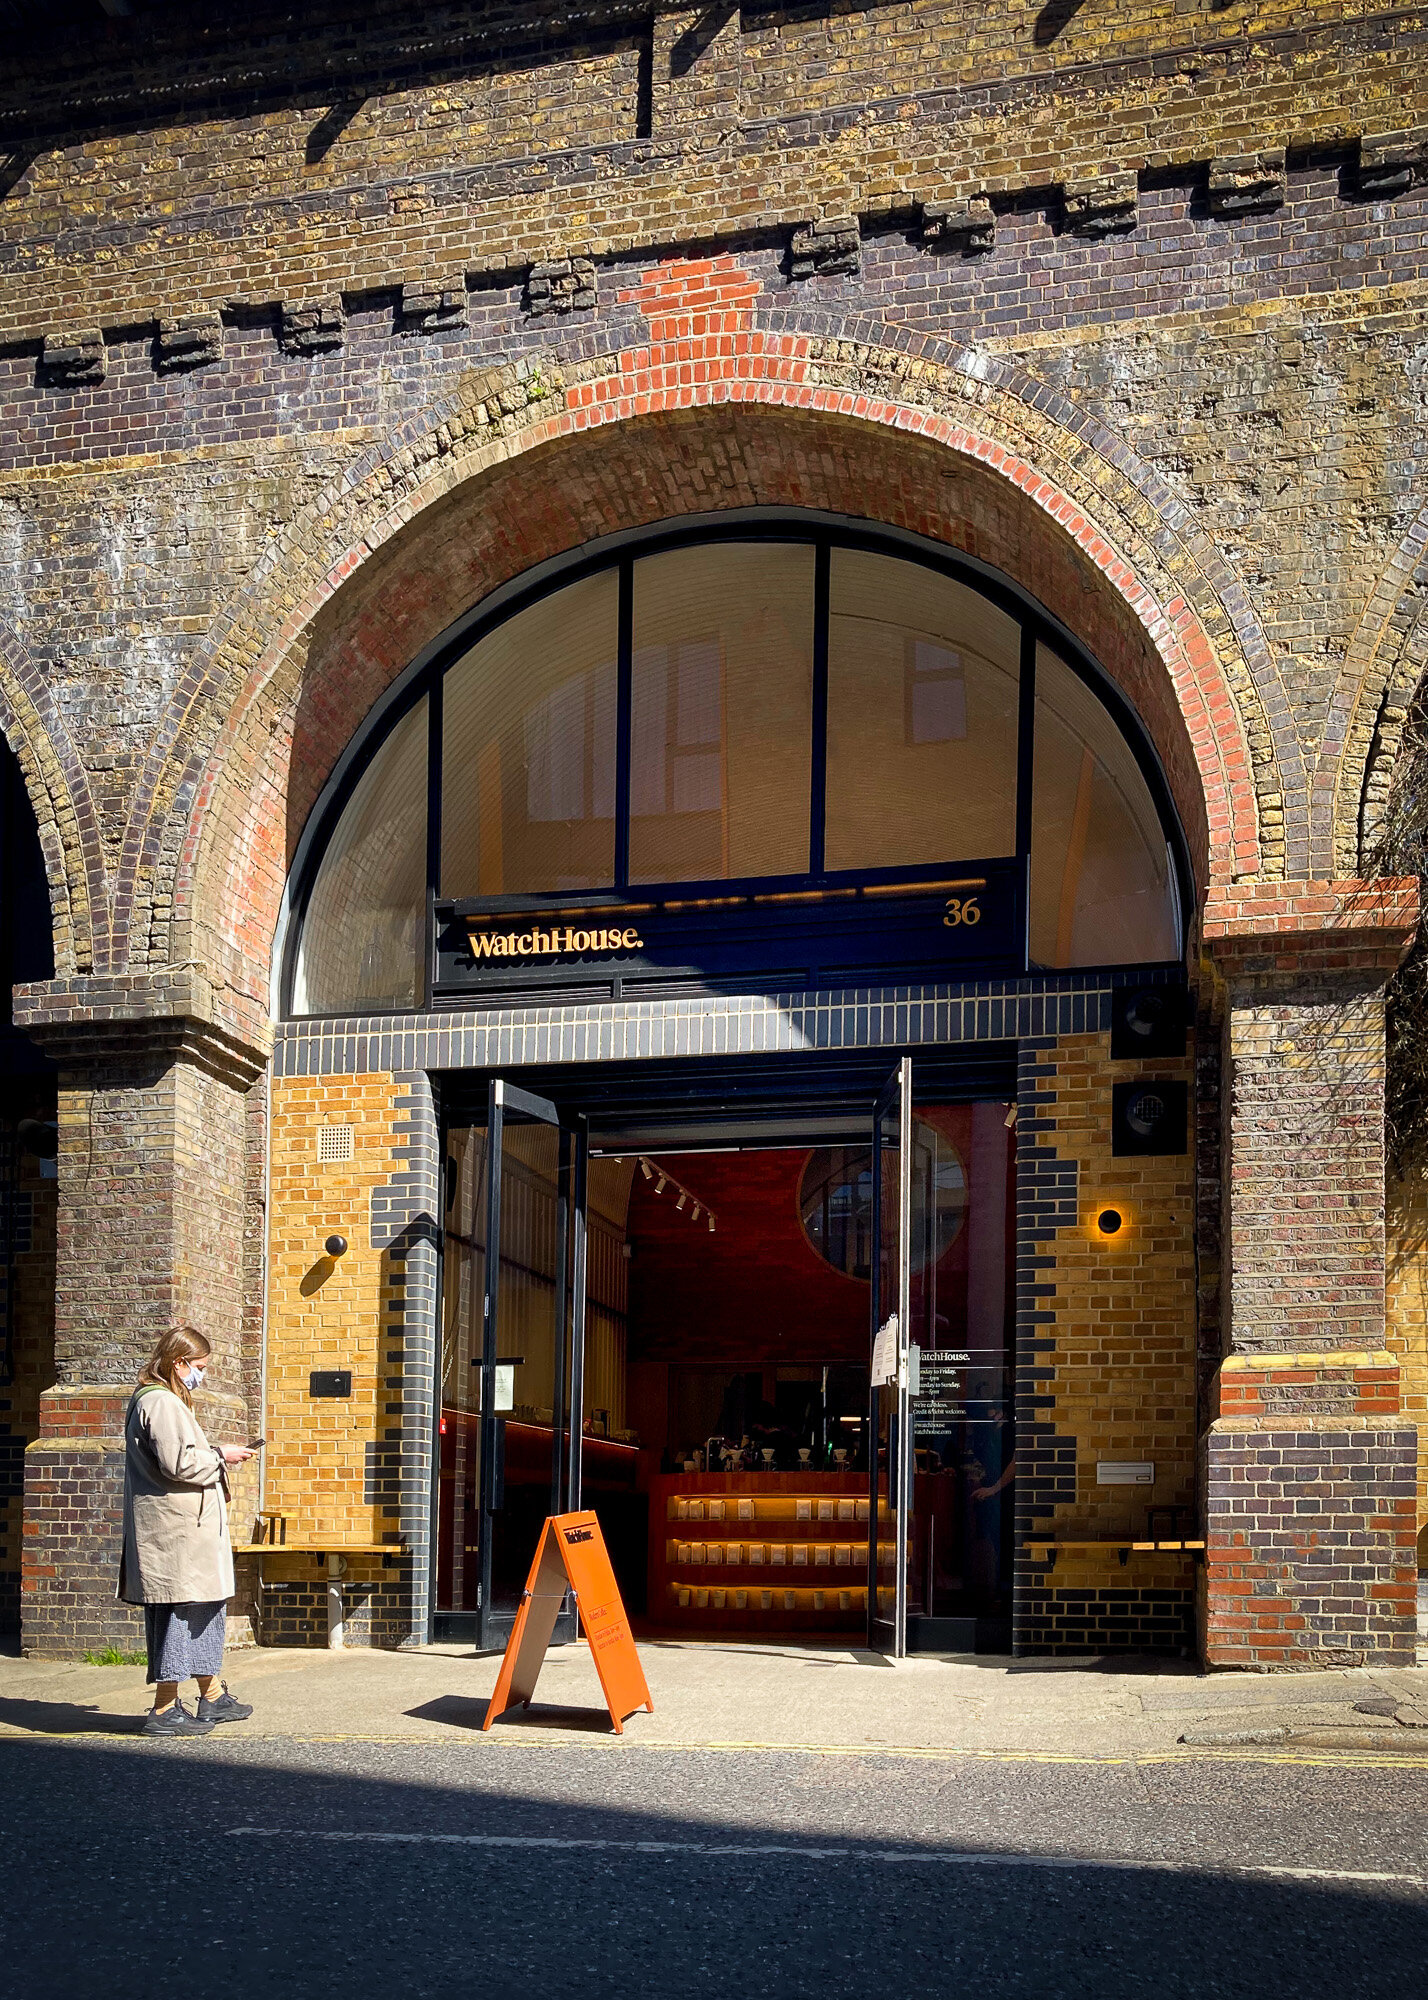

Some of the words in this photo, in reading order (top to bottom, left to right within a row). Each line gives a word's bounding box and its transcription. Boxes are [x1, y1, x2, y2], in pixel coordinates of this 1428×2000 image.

[943, 897, 981, 926] 36
[467, 926, 644, 958] WatchHouse.
[919, 1352, 971, 1361] atchHouse.
